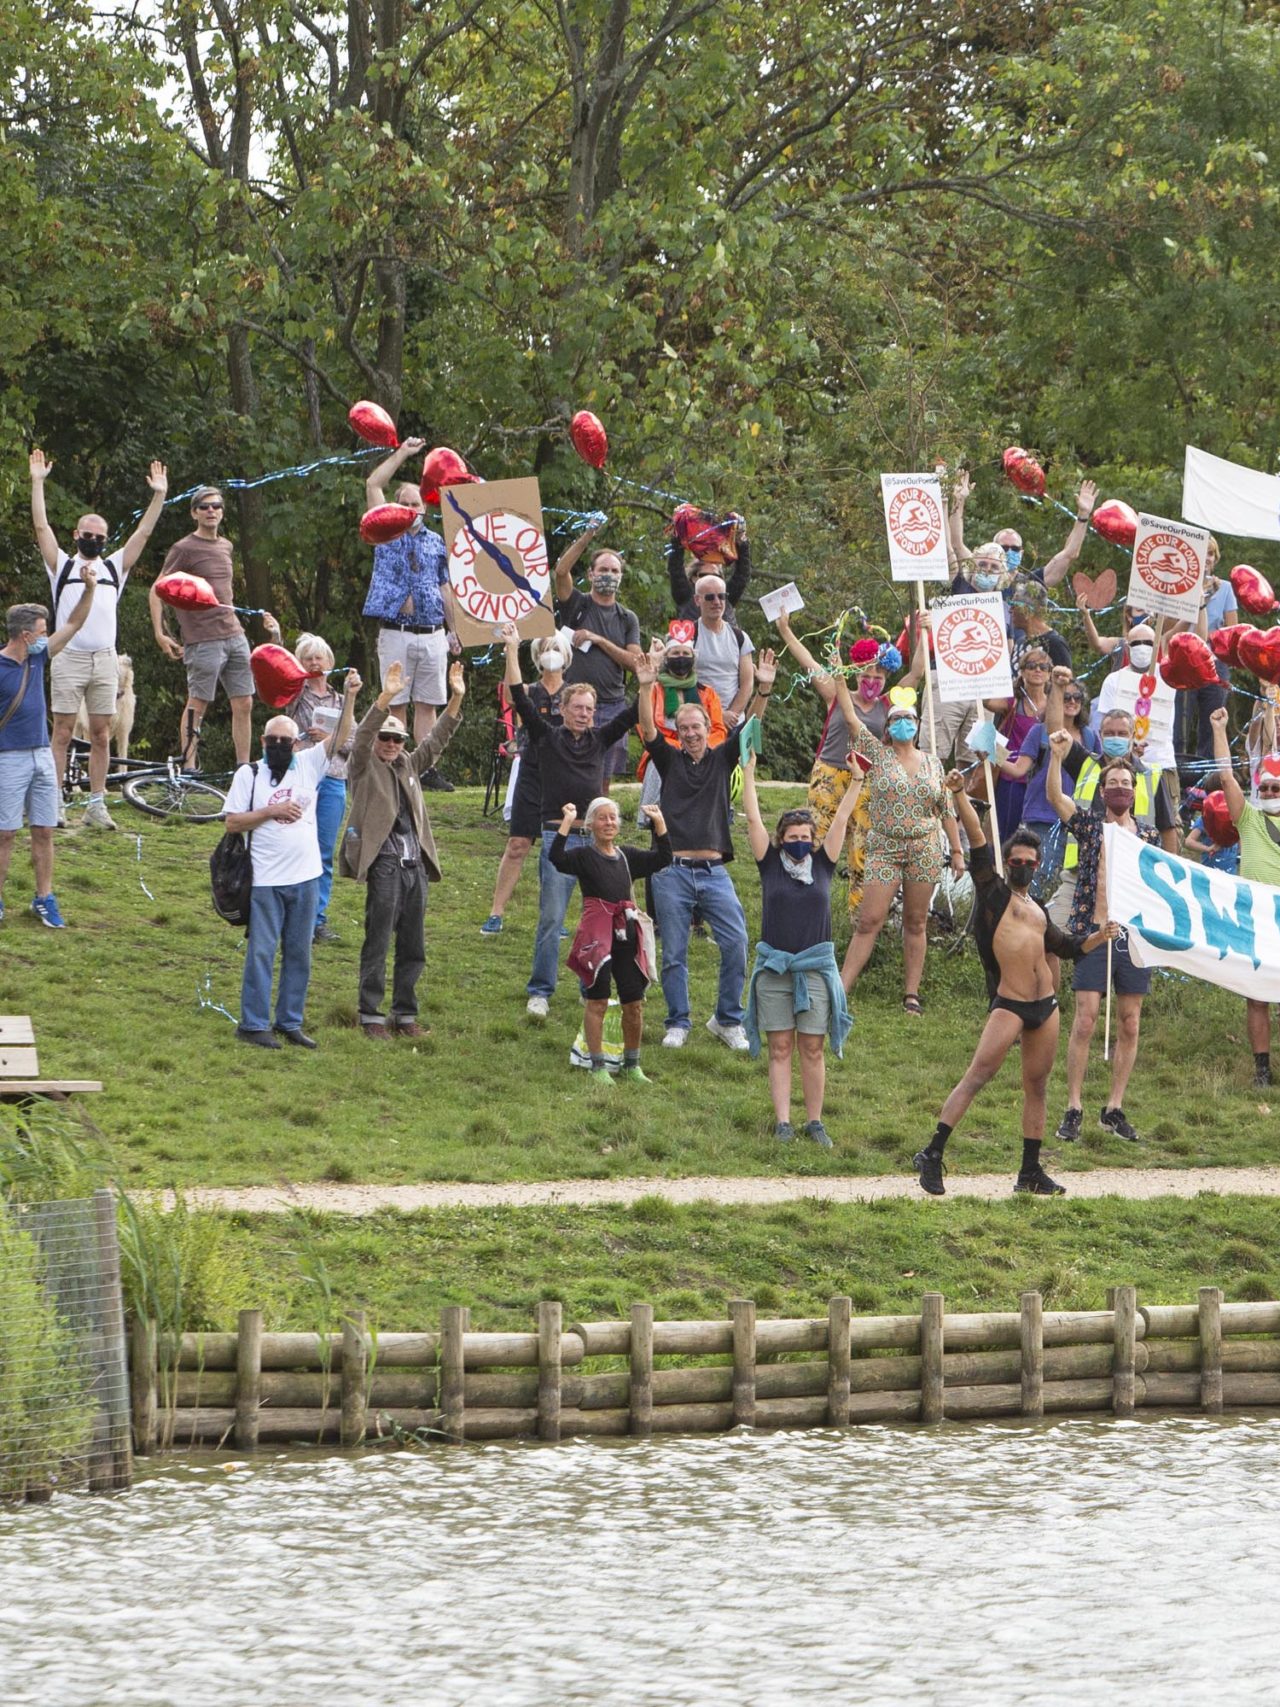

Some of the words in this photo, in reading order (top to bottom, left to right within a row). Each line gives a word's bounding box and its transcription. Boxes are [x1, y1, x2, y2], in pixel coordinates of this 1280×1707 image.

[900, 489, 919, 501] OUR
[451, 512, 507, 565] SAVE
[896, 533, 928, 554] FORUM
[1141, 518, 1205, 540] @SaveOurPonds
[515, 528, 549, 577] OUR
[1138, 537, 1157, 564] SAVE
[1156, 535, 1179, 548] OUR
[1180, 543, 1198, 577] PONDS
[1140, 567, 1177, 593] FORUM
[455, 575, 533, 621] PONDS
[939, 620, 954, 650] SAVE
[952, 610, 975, 624] OUR
[977, 612, 1001, 646] PONDS
[945, 654, 986, 674] FORUM
